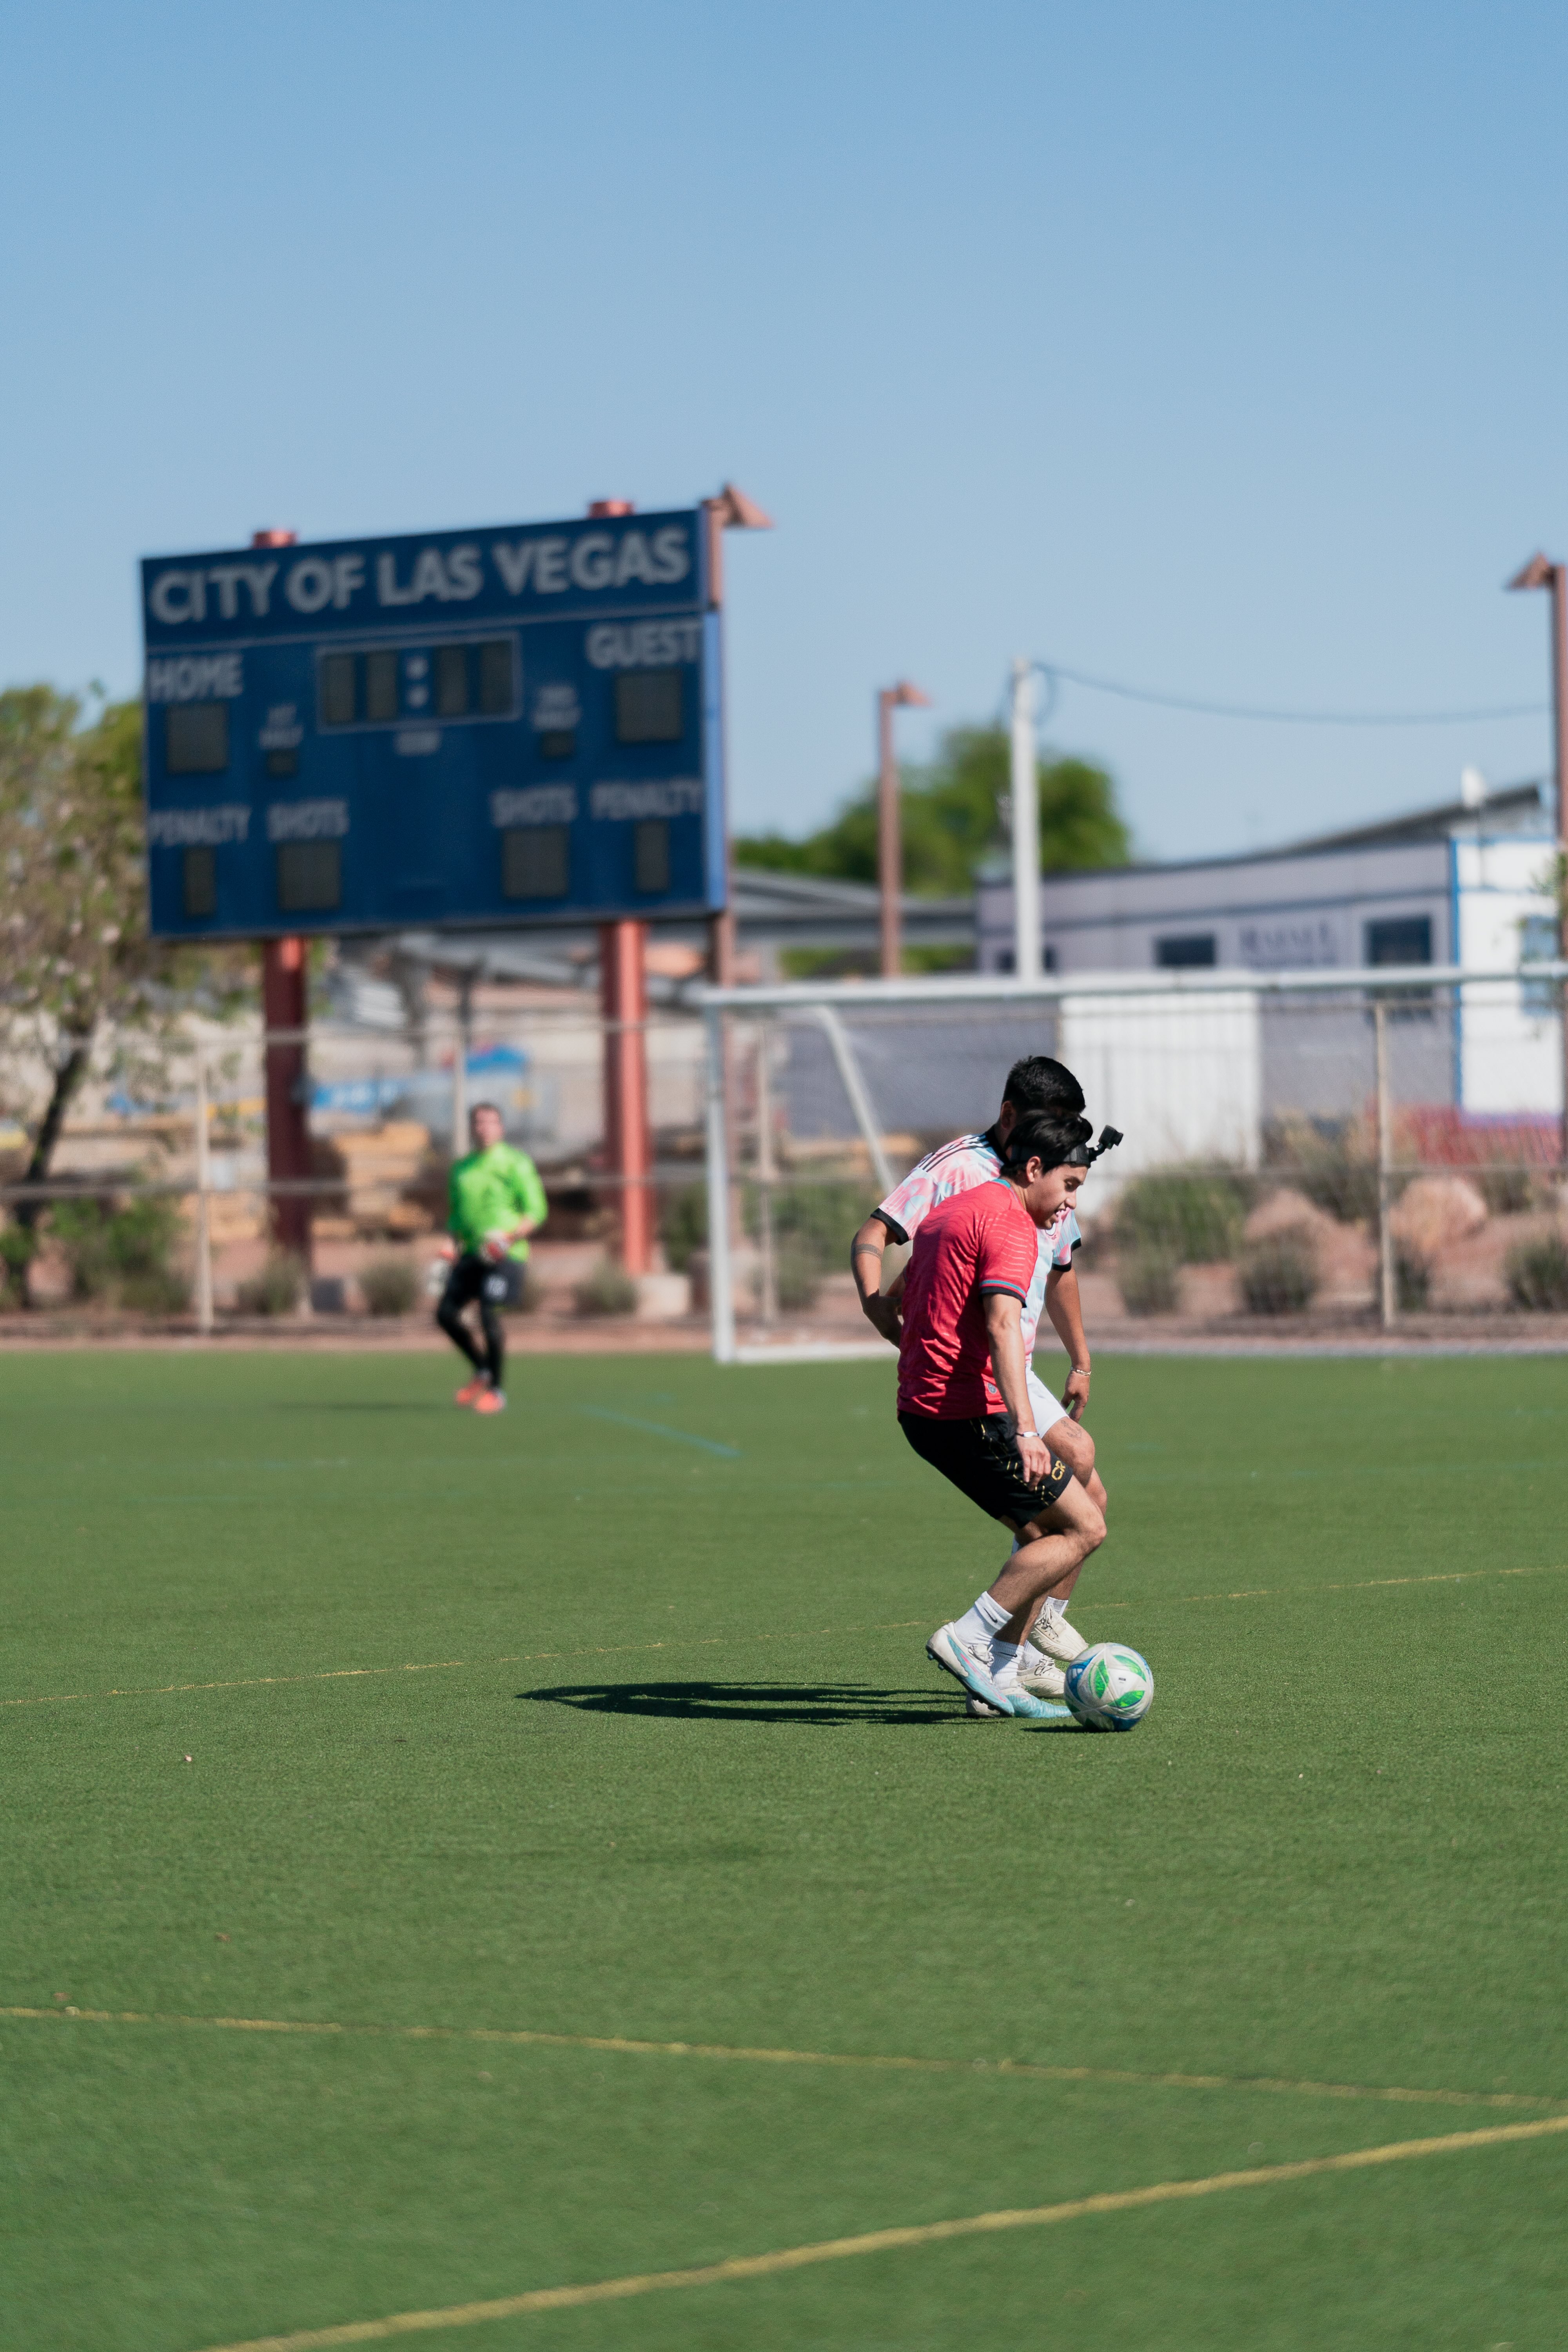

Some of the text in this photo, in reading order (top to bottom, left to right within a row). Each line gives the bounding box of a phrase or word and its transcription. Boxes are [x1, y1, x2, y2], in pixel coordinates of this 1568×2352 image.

[151, 528, 687, 622] CITY OF LAS VEGAS
[587, 622, 700, 667] GUEST
[149, 655, 241, 701] HOME
